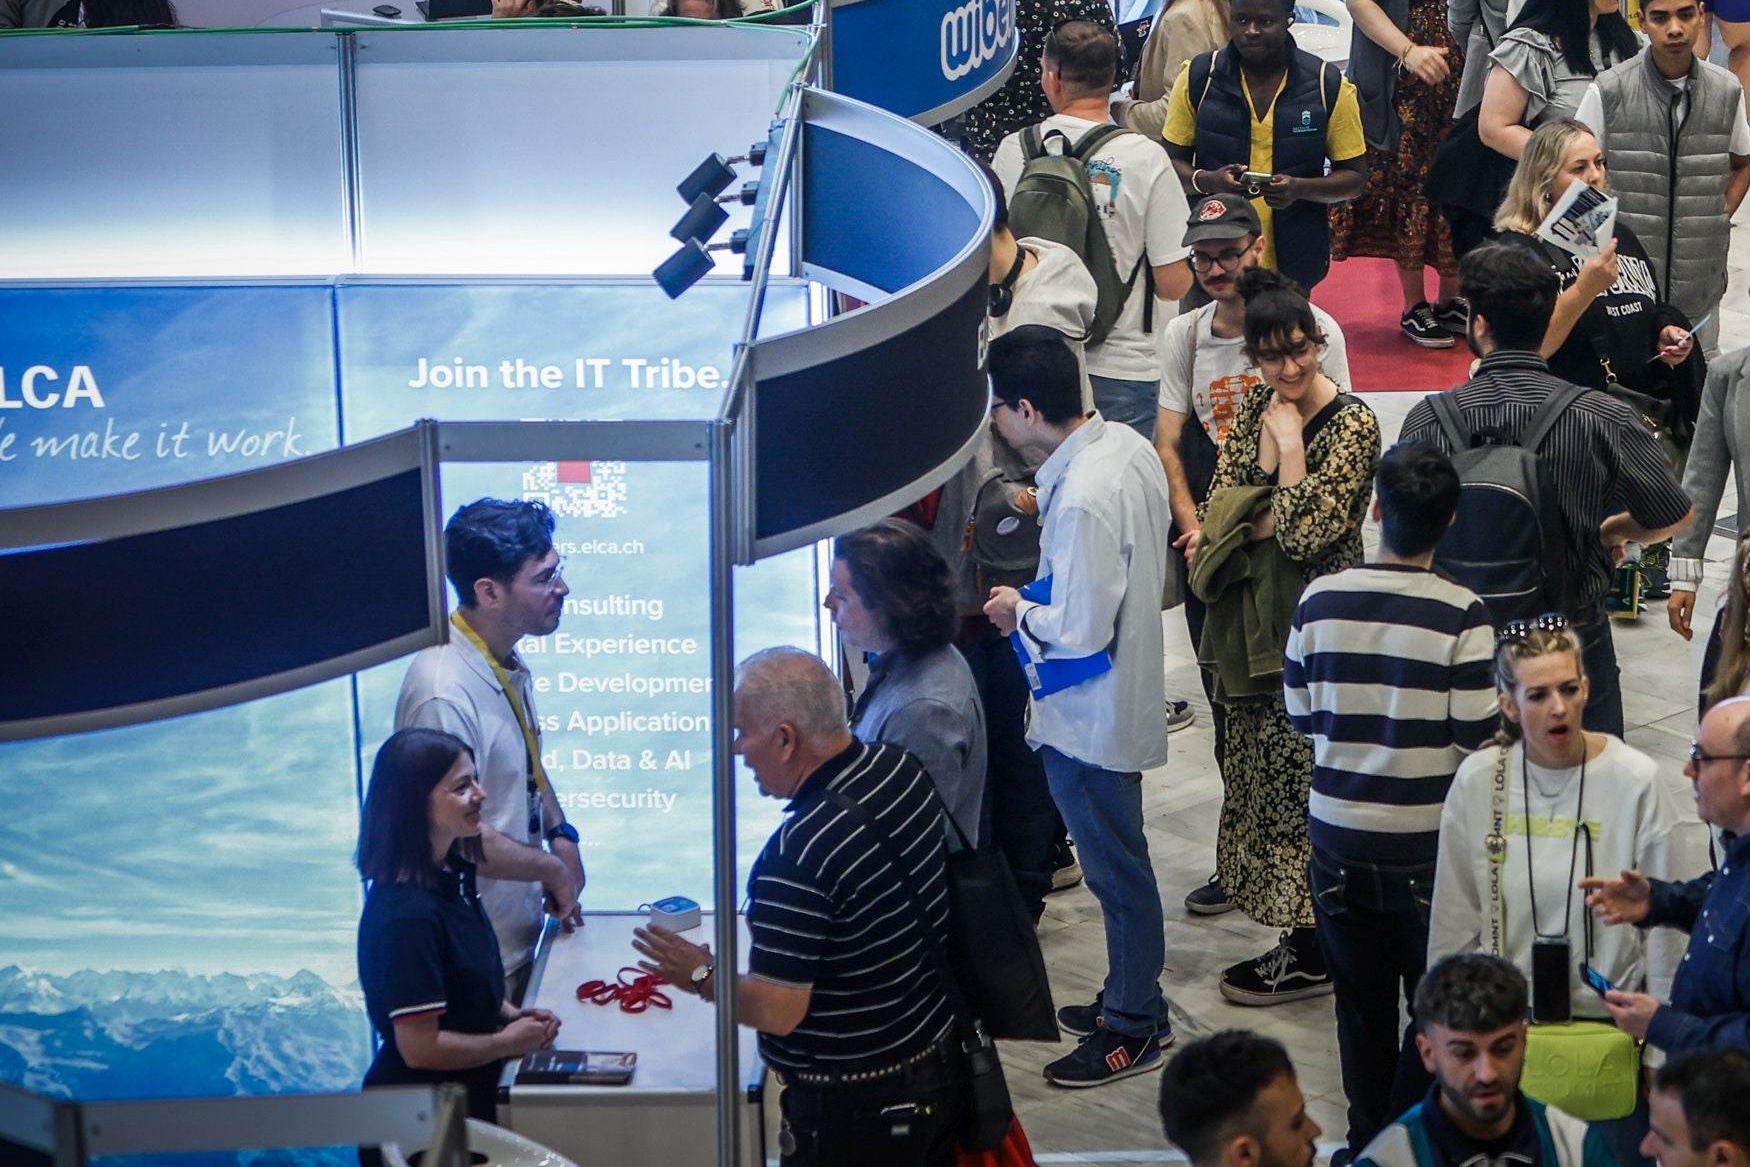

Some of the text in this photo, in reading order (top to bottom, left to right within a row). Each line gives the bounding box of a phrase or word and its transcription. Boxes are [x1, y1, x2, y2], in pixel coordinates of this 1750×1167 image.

[1620, 301, 1643, 316] COAST
[408, 356, 730, 389] Join the IT Tribe.
[0, 416, 312, 461] e make it work.
[563, 595, 664, 620] nsulting
[517, 634, 698, 659] tal Experience
[533, 676, 550, 693] e
[538, 714, 560, 732] ss
[543, 749, 691, 772] d, Data & AI
[1494, 757, 1508, 792] LOLA
[556, 788, 678, 814] ersecurity
[1490, 867, 1499, 902] LOLA
[1490, 918, 1500, 957] OMNT
